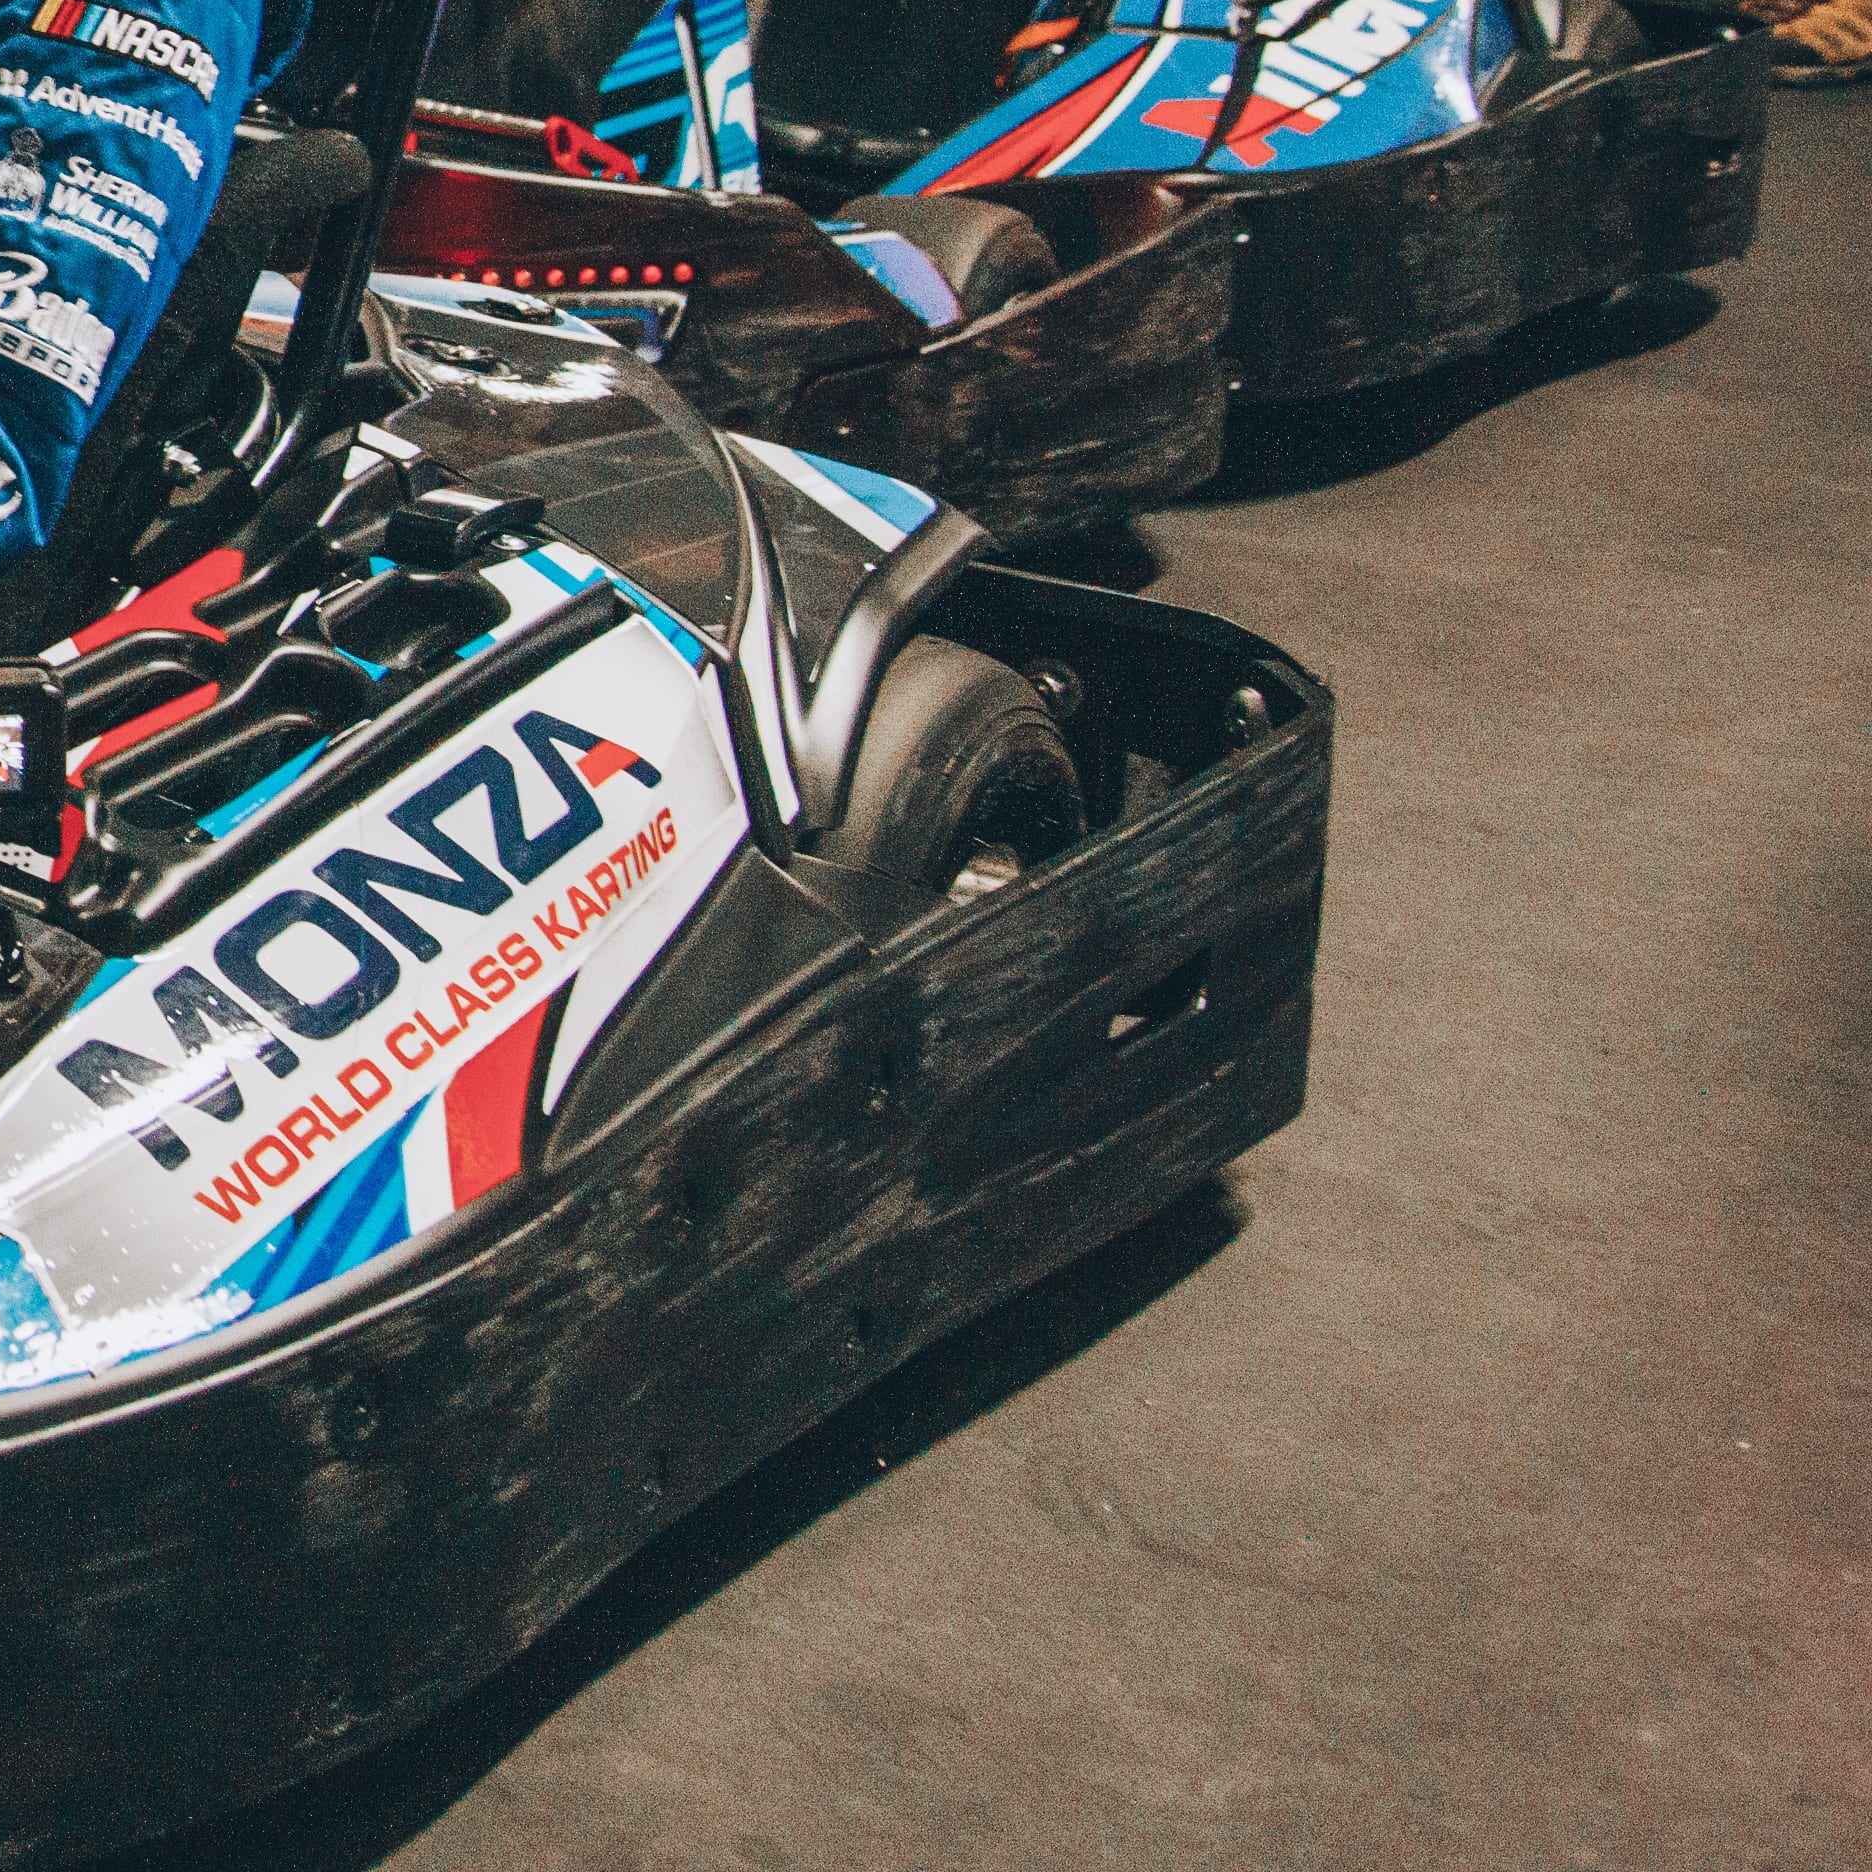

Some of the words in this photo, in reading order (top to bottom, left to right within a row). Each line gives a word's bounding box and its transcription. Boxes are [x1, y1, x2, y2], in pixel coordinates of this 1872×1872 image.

[55, 709, 663, 1172] MONZA
[193, 1056, 394, 1226] WORLD
[384, 932, 543, 1073] CLASS
[531, 806, 679, 952] KARTING
